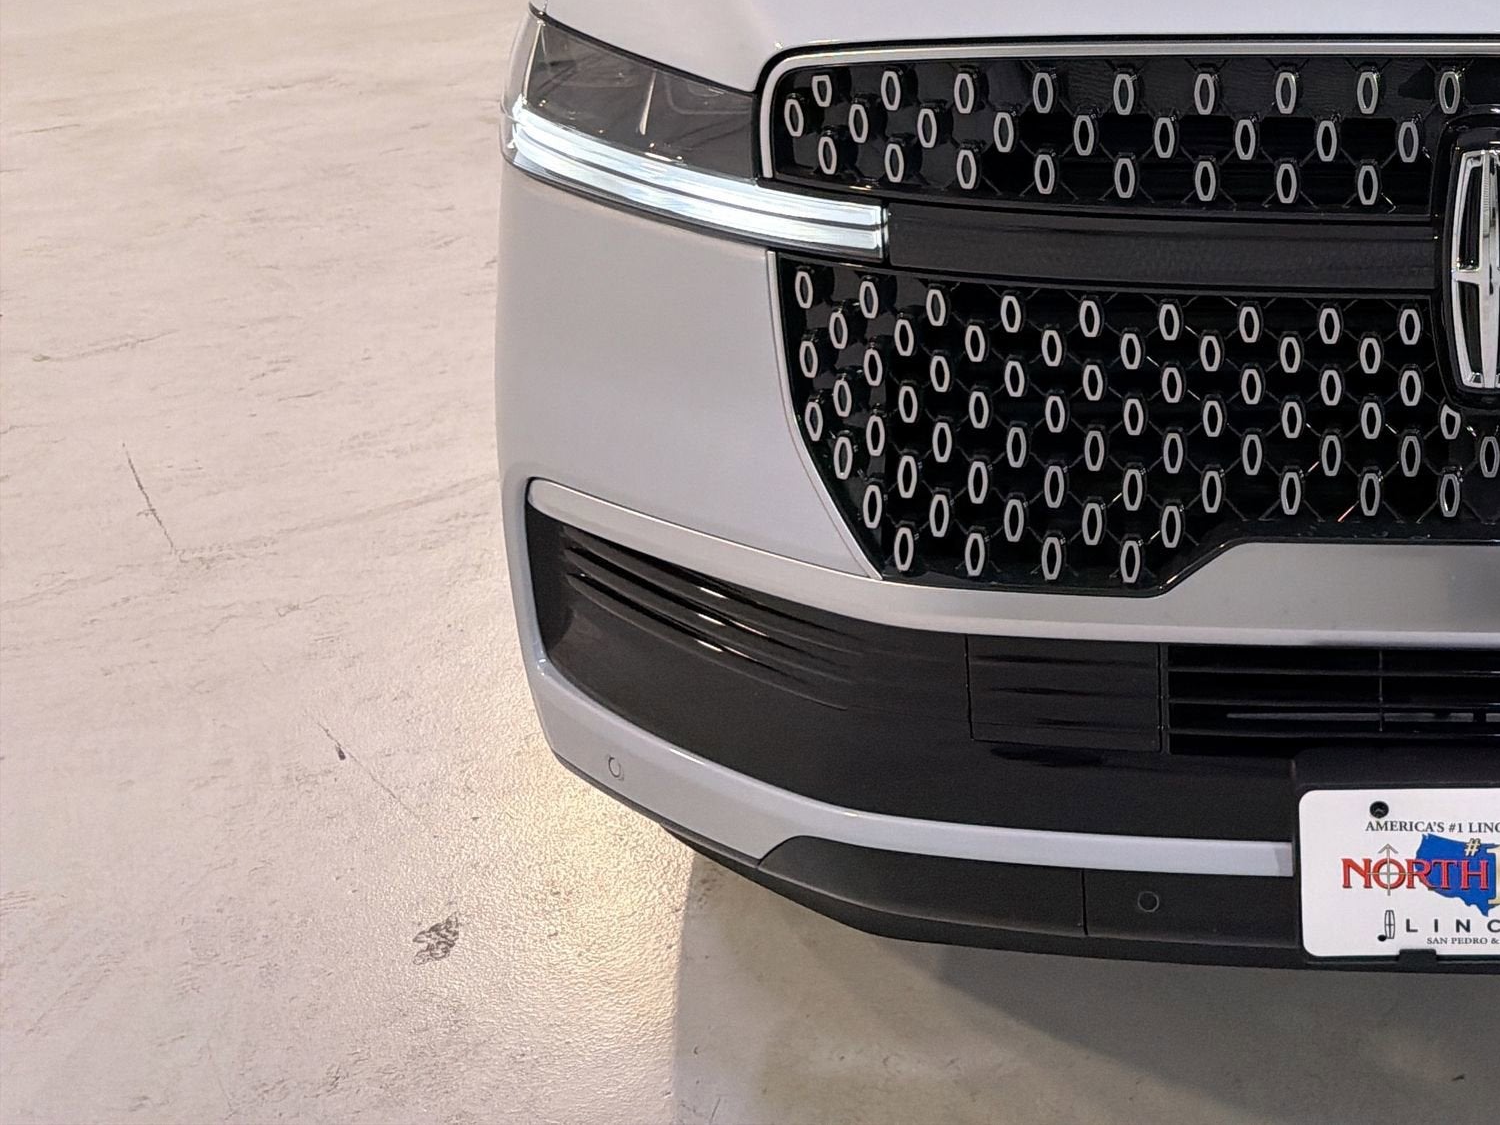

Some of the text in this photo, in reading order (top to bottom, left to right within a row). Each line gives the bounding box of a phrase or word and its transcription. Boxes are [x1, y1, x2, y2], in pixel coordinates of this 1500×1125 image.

[1365, 820, 1445, 833] AMERICA'S
[1448, 822, 1463, 833] #1
[1341, 857, 1489, 890] NORTH
[1427, 937, 1448, 945] SAN
[1450, 937, 1489, 945] PEDRO
[1491, 937, 1500, 945] &
